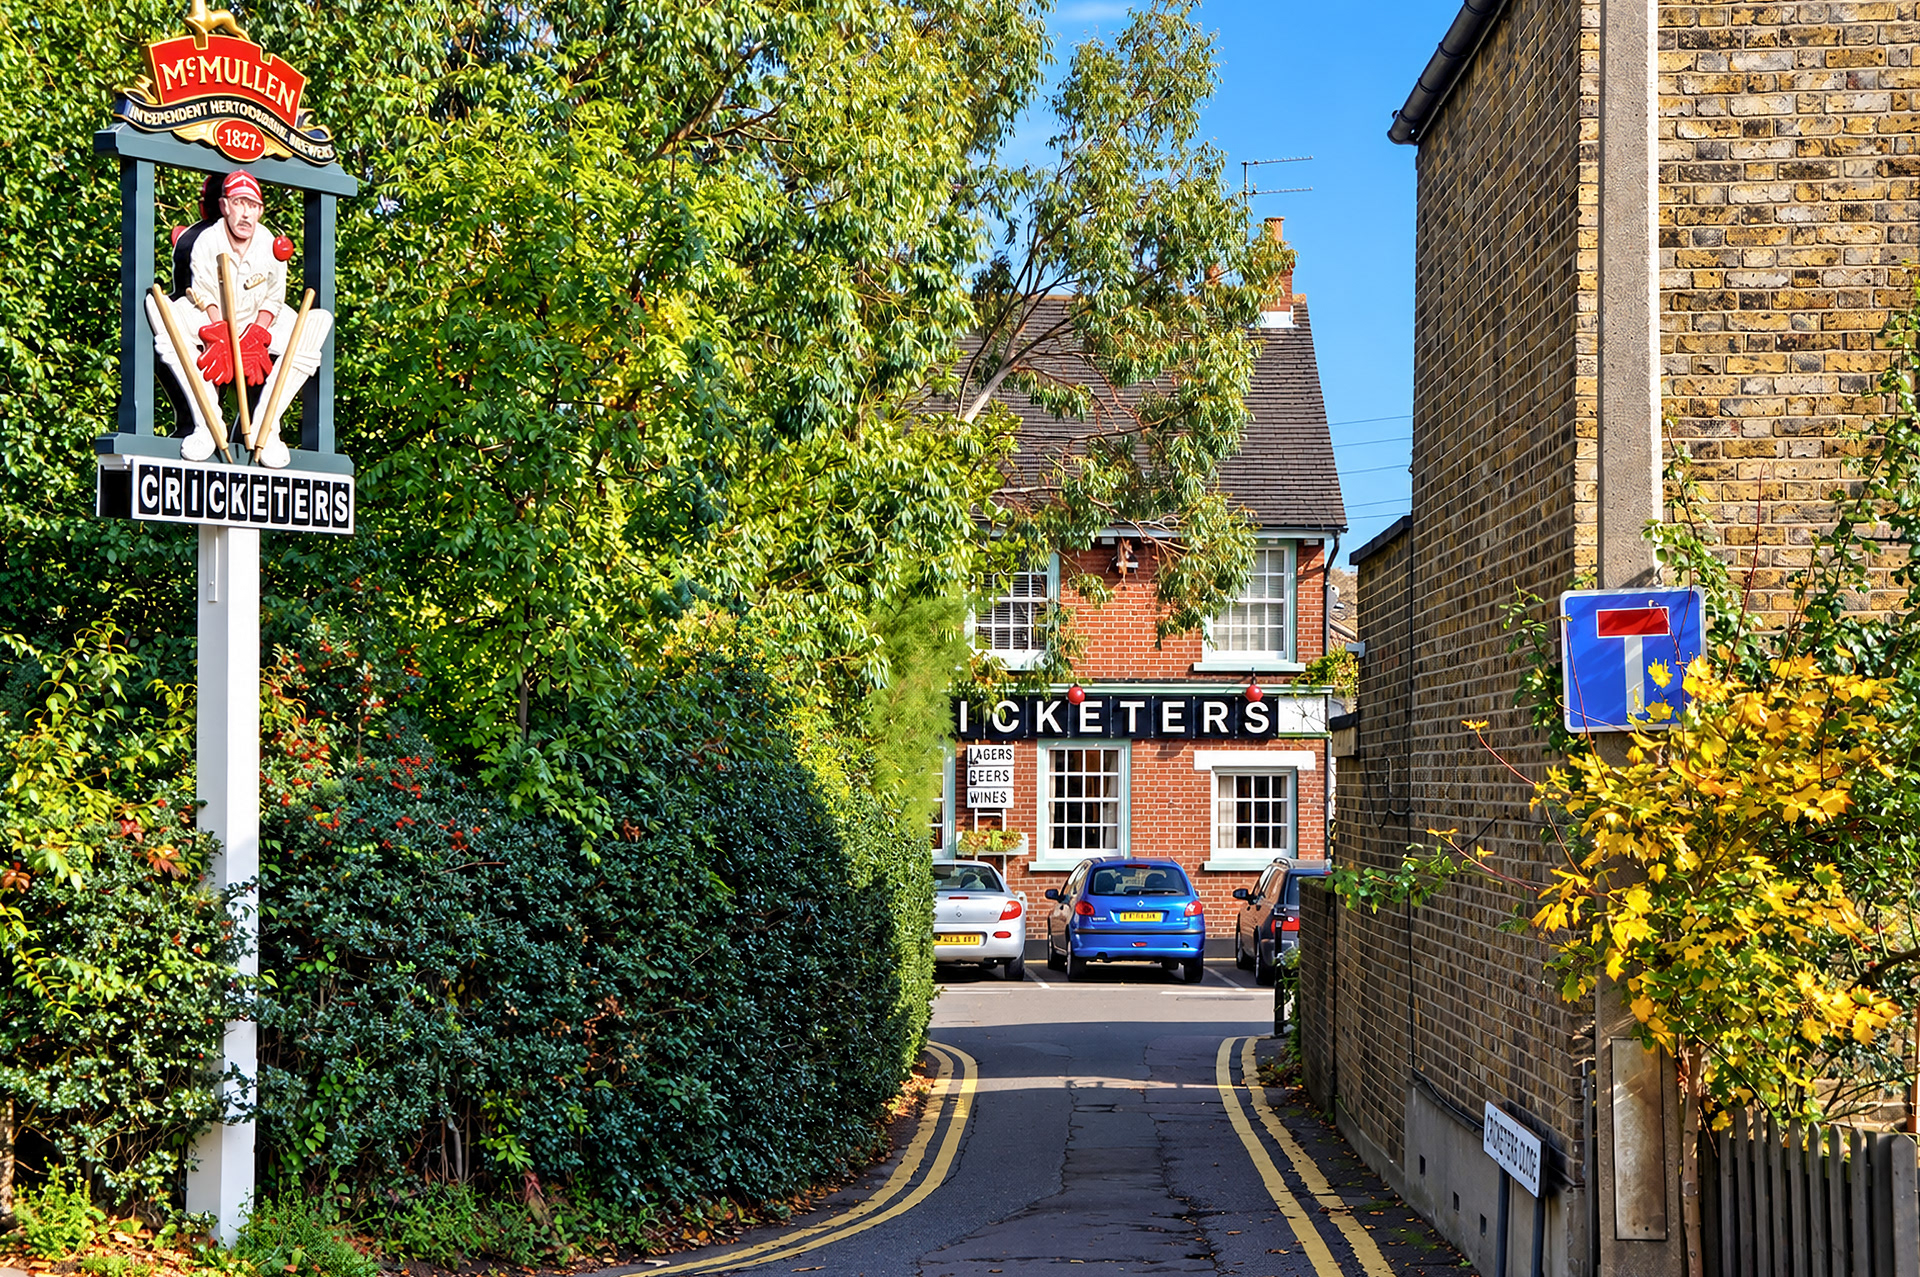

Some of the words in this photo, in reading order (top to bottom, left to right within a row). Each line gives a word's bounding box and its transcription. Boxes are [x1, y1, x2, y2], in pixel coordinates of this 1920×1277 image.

[140, 473, 349, 523] CRICKETERS
[960, 699, 1270, 734] ICKETERS
[969, 748, 1012, 764] LAGERS
[969, 770, 1010, 786] BEERS
[970, 790, 1007, 804] WINES
